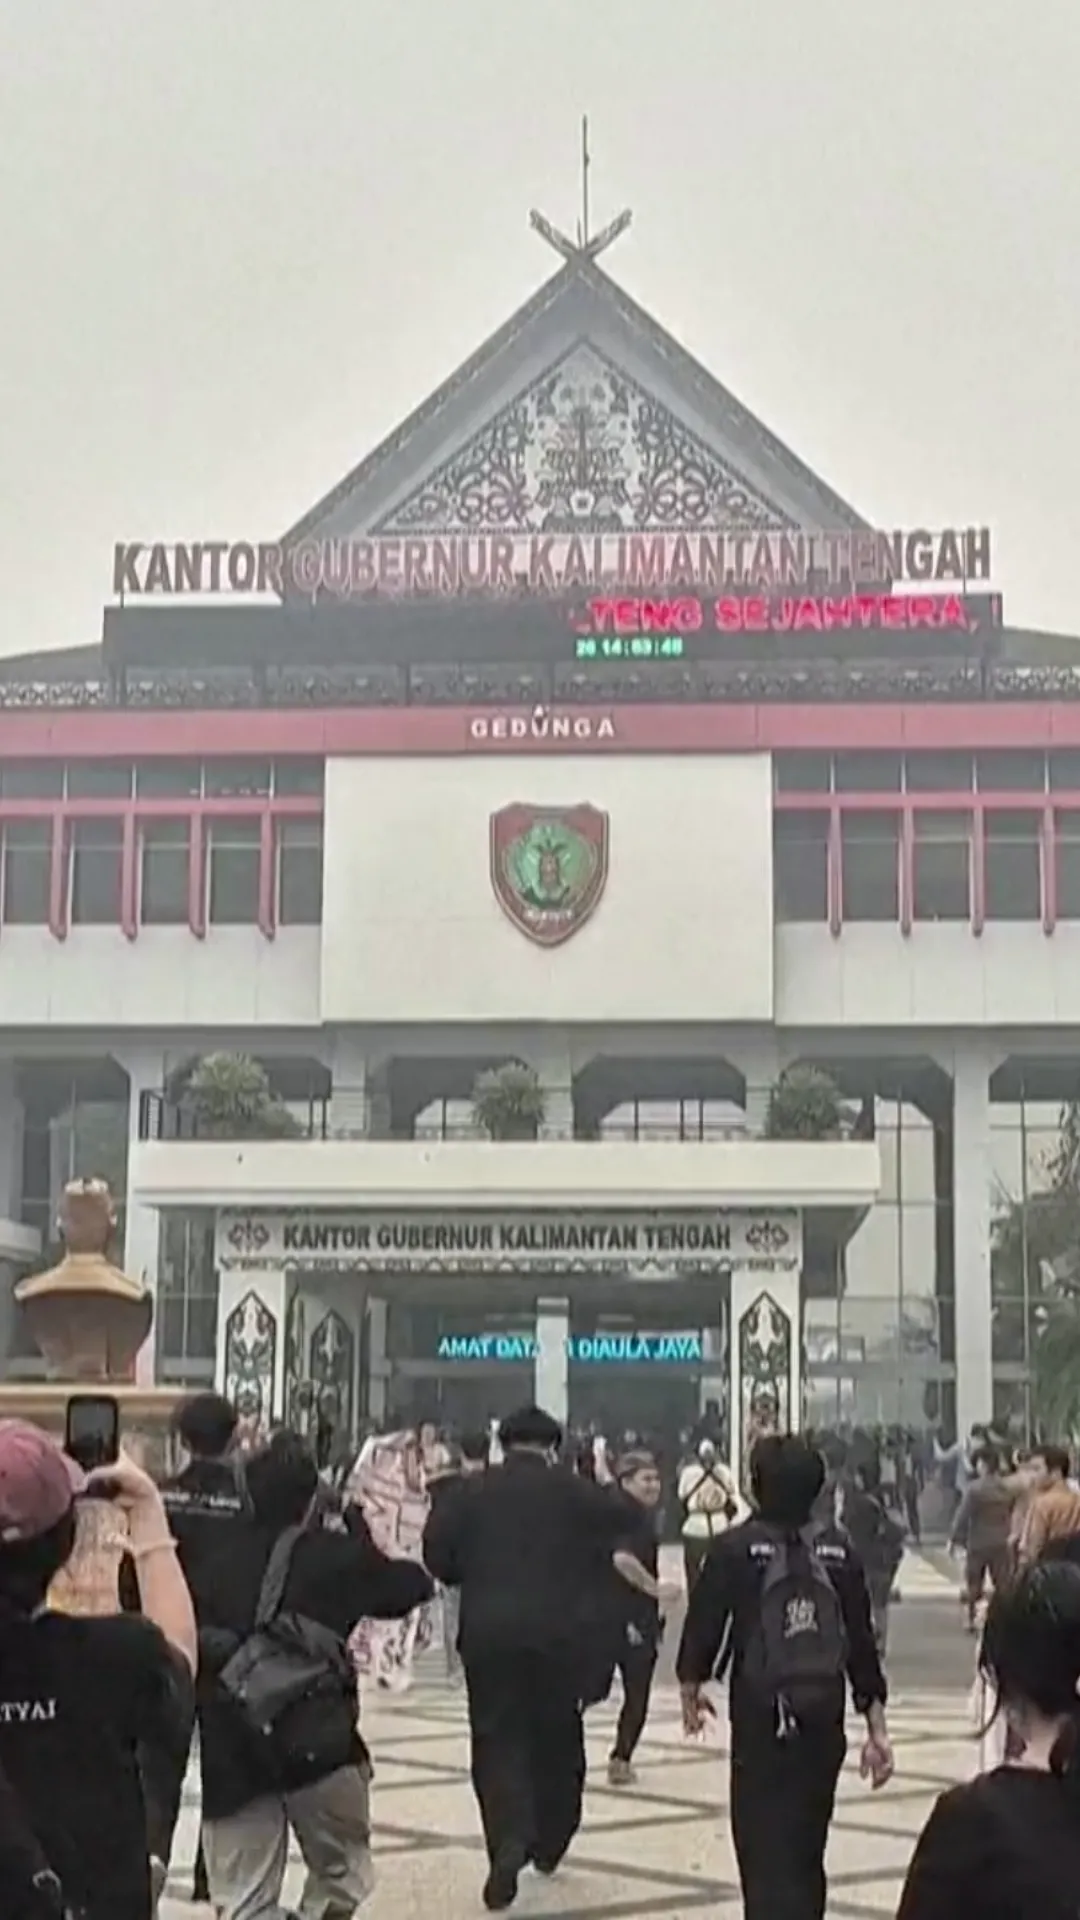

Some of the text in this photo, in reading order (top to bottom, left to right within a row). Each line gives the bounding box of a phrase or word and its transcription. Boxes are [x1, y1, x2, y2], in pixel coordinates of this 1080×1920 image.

[113, 527, 990, 593] KANTOR GUBERNUR KALIMANTAN TENGAH
[283, 1223, 731, 1249] KANTOR GUBERNUR KALIMANTAN TENGAH
[654, 1336, 701, 1360] JAYA
[0, 1698, 57, 1722] TYAI
